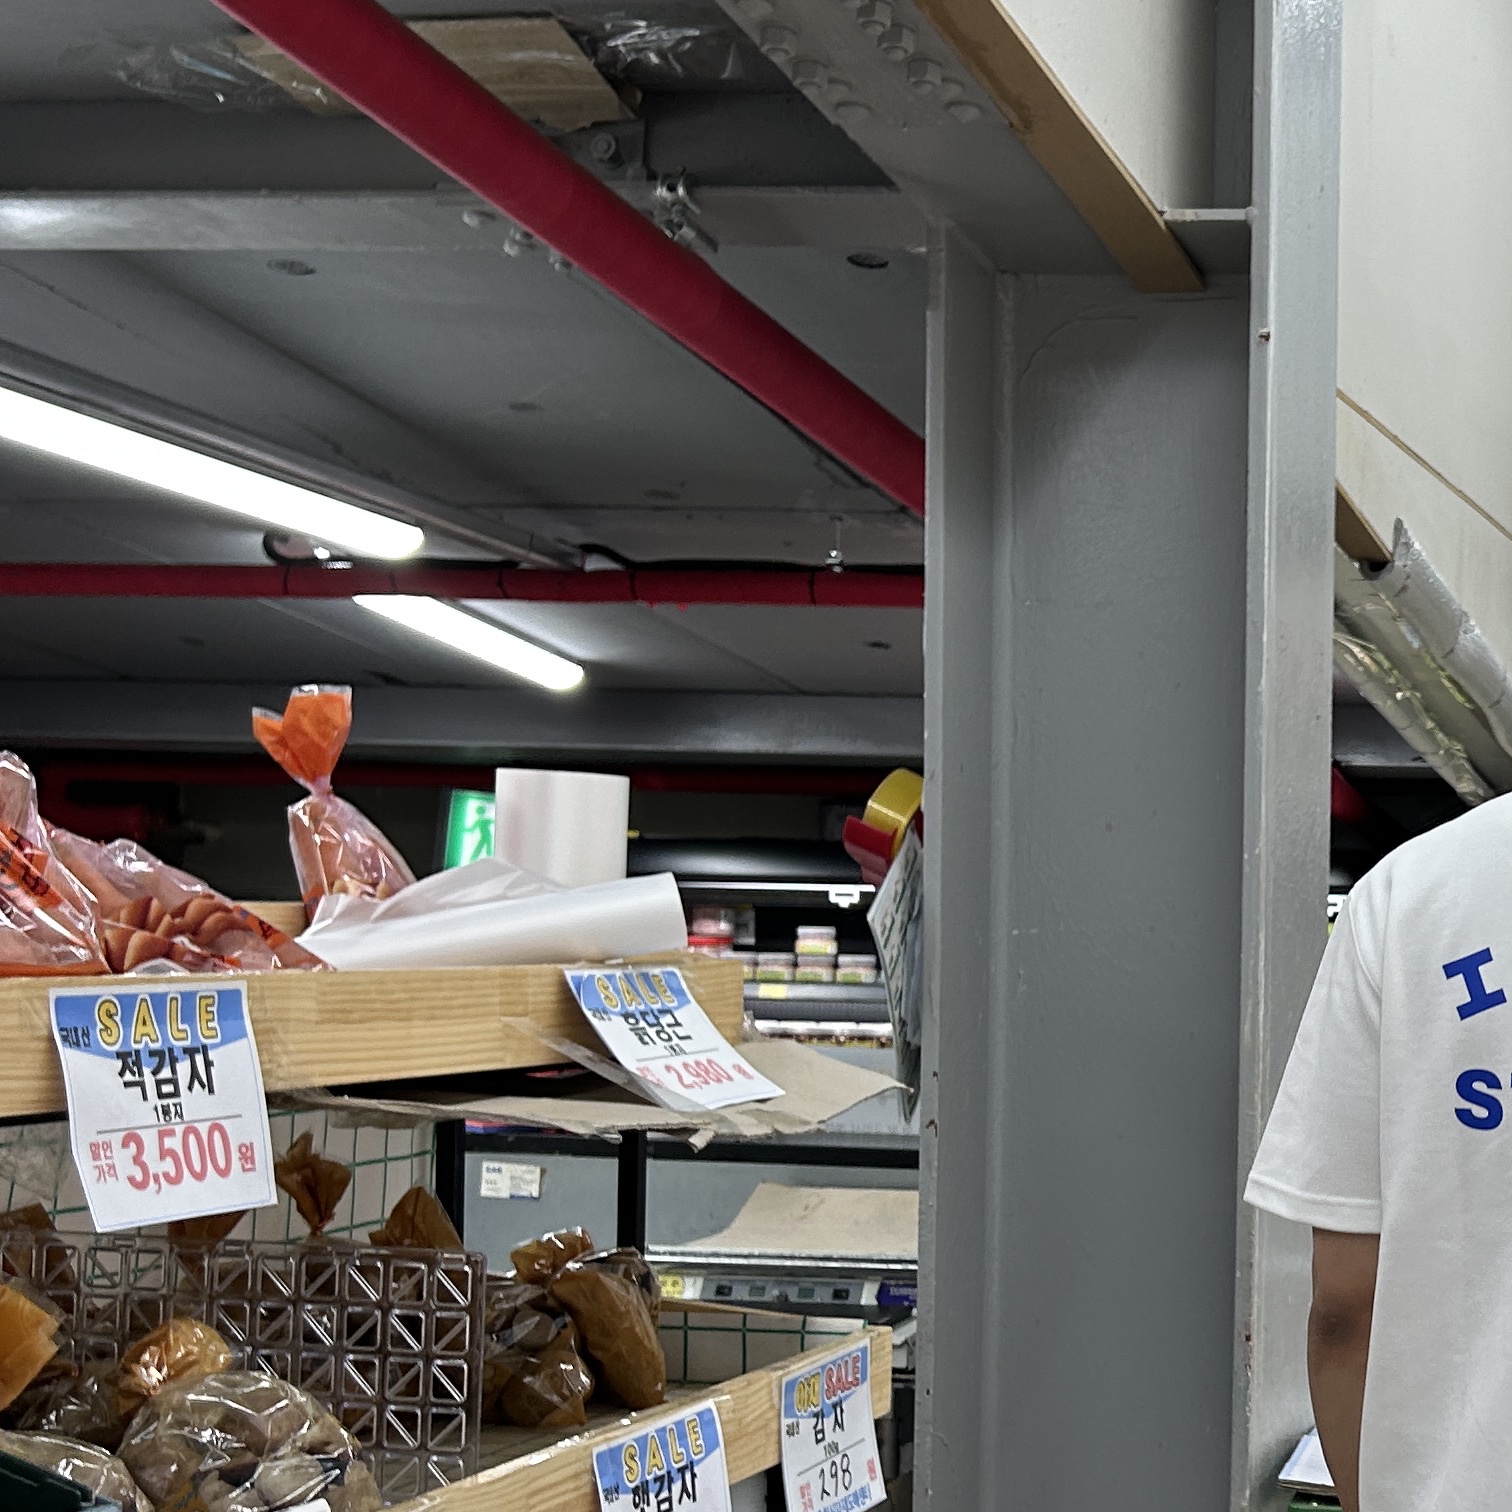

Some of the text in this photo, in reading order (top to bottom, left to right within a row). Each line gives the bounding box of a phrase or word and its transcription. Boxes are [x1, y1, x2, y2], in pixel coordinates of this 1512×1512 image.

[596, 974, 677, 1011] SALE
[96, 992, 221, 1048] SALE
[623, 1008, 694, 1046] 흙당근
[116, 1044, 215, 1102] 적감자
[152, 1101, 186, 1123] 1봉지
[121, 1122, 257, 1194] 3,500 원
[825, 1354, 861, 1400] SALE
[622, 1417, 704, 1484] SALE
